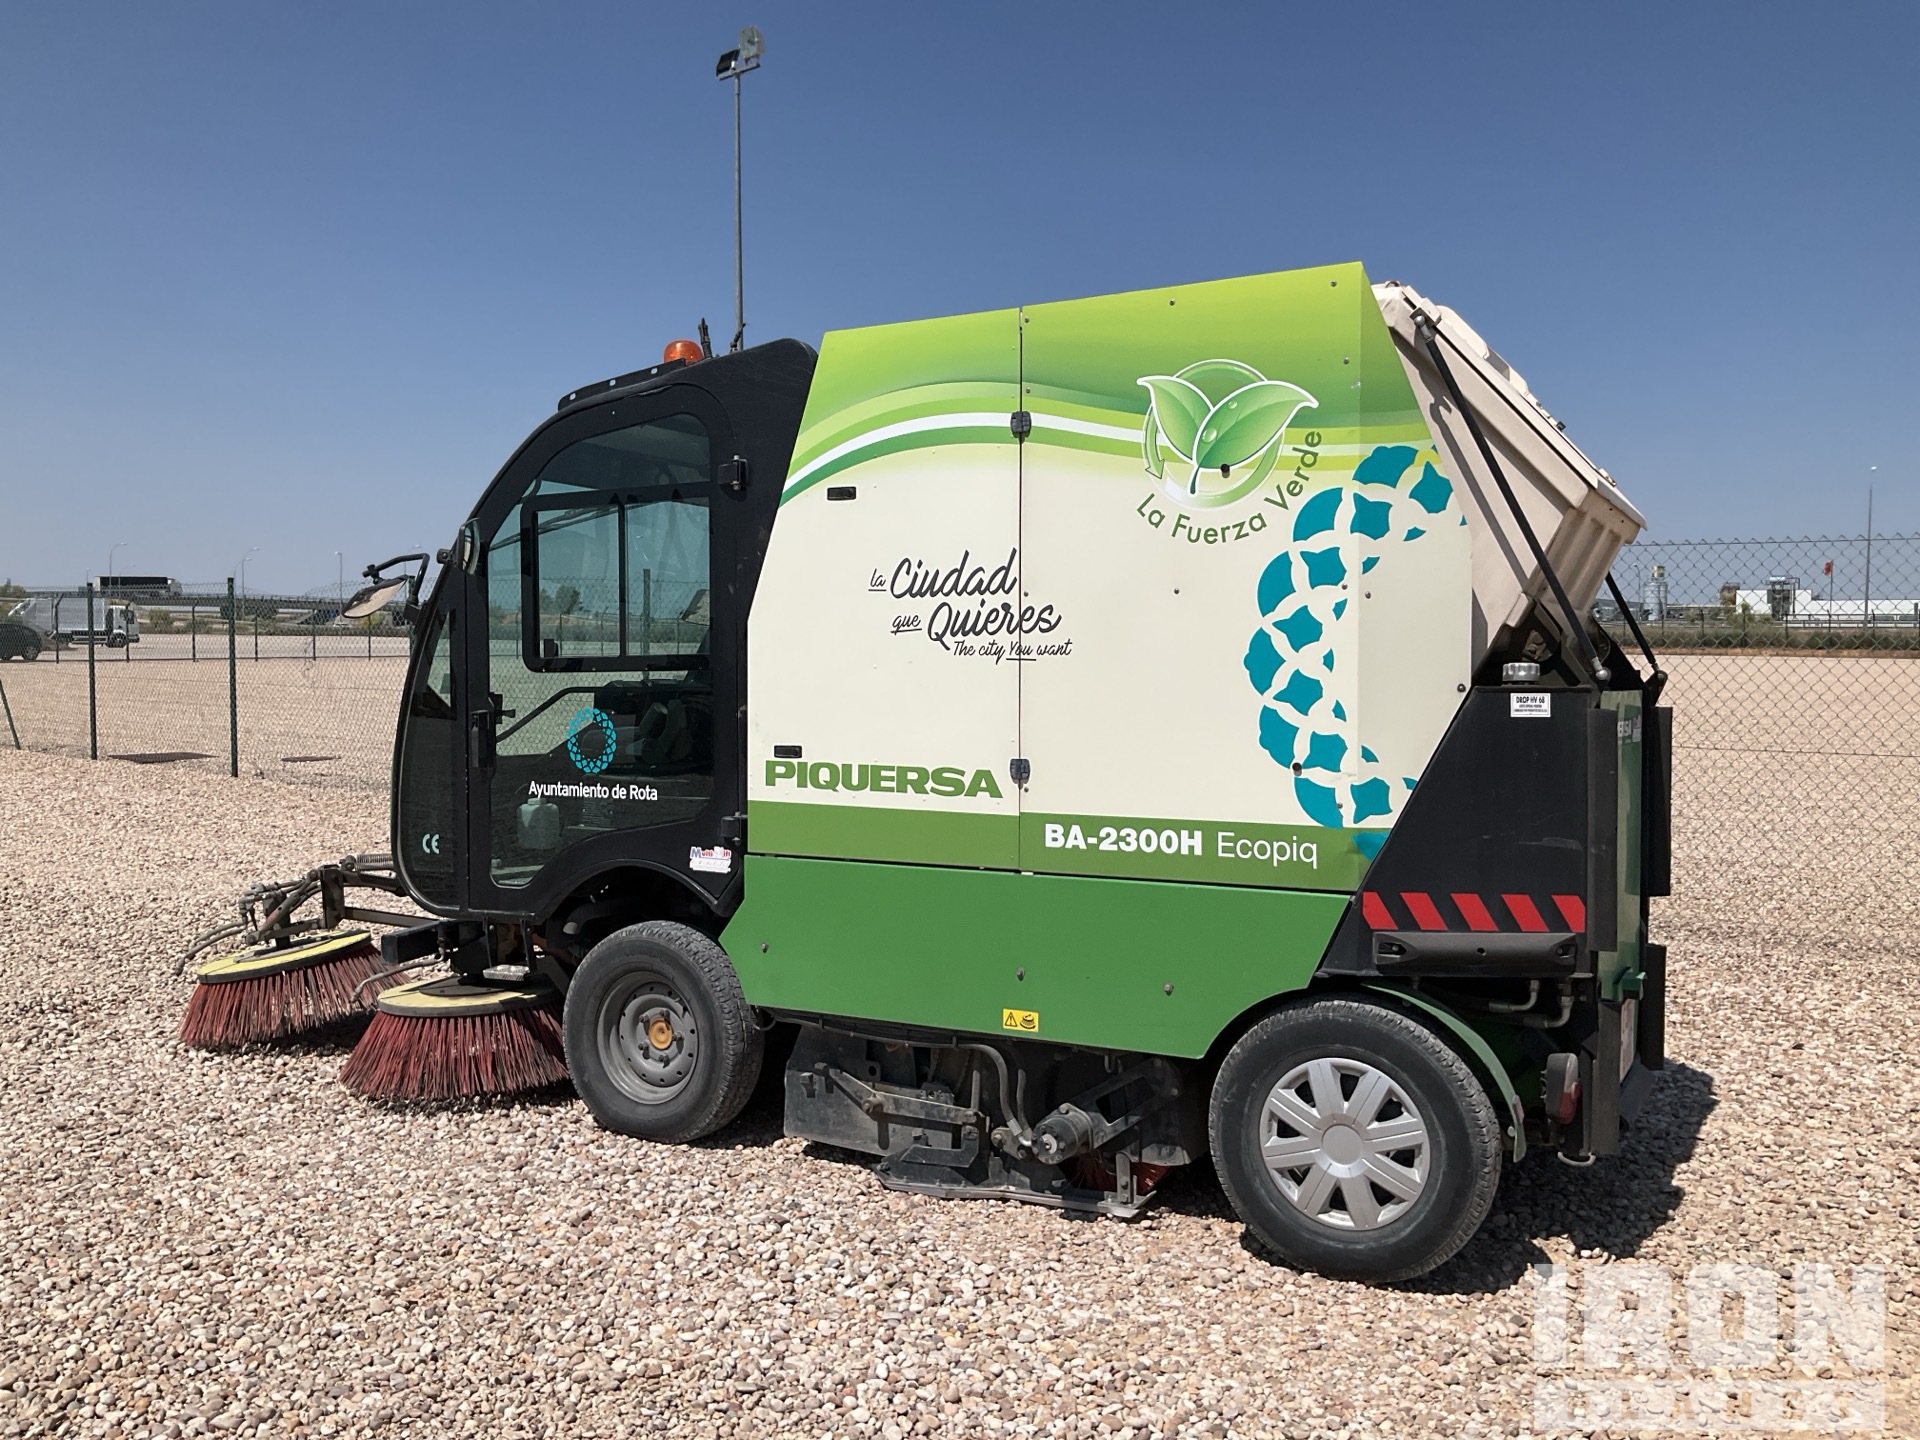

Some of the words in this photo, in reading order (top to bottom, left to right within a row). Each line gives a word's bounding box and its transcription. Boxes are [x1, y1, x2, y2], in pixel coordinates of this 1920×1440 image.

[1136, 492, 1166, 529] La
[1171, 512, 1268, 545] Fuerza
[1263, 430, 1322, 511] Verde
[890, 547, 1018, 599] Ciudad
[891, 614, 922, 635] que
[927, 598, 1062, 651] Quieres
[953, 640, 976, 656] The
[978, 639, 1006, 665] city
[1008, 640, 1034, 658] You
[1036, 638, 1073, 657] want
[1516, 696, 1530, 704] DROP
[528, 780, 610, 799] Ayuntamiento
[611, 783, 627, 800] de
[629, 784, 658, 801] Rota
[765, 760, 1004, 799] PIQUERSA
[1045, 823, 1202, 856] BA-2300H
[1217, 831, 1318, 870] Ecopiq
